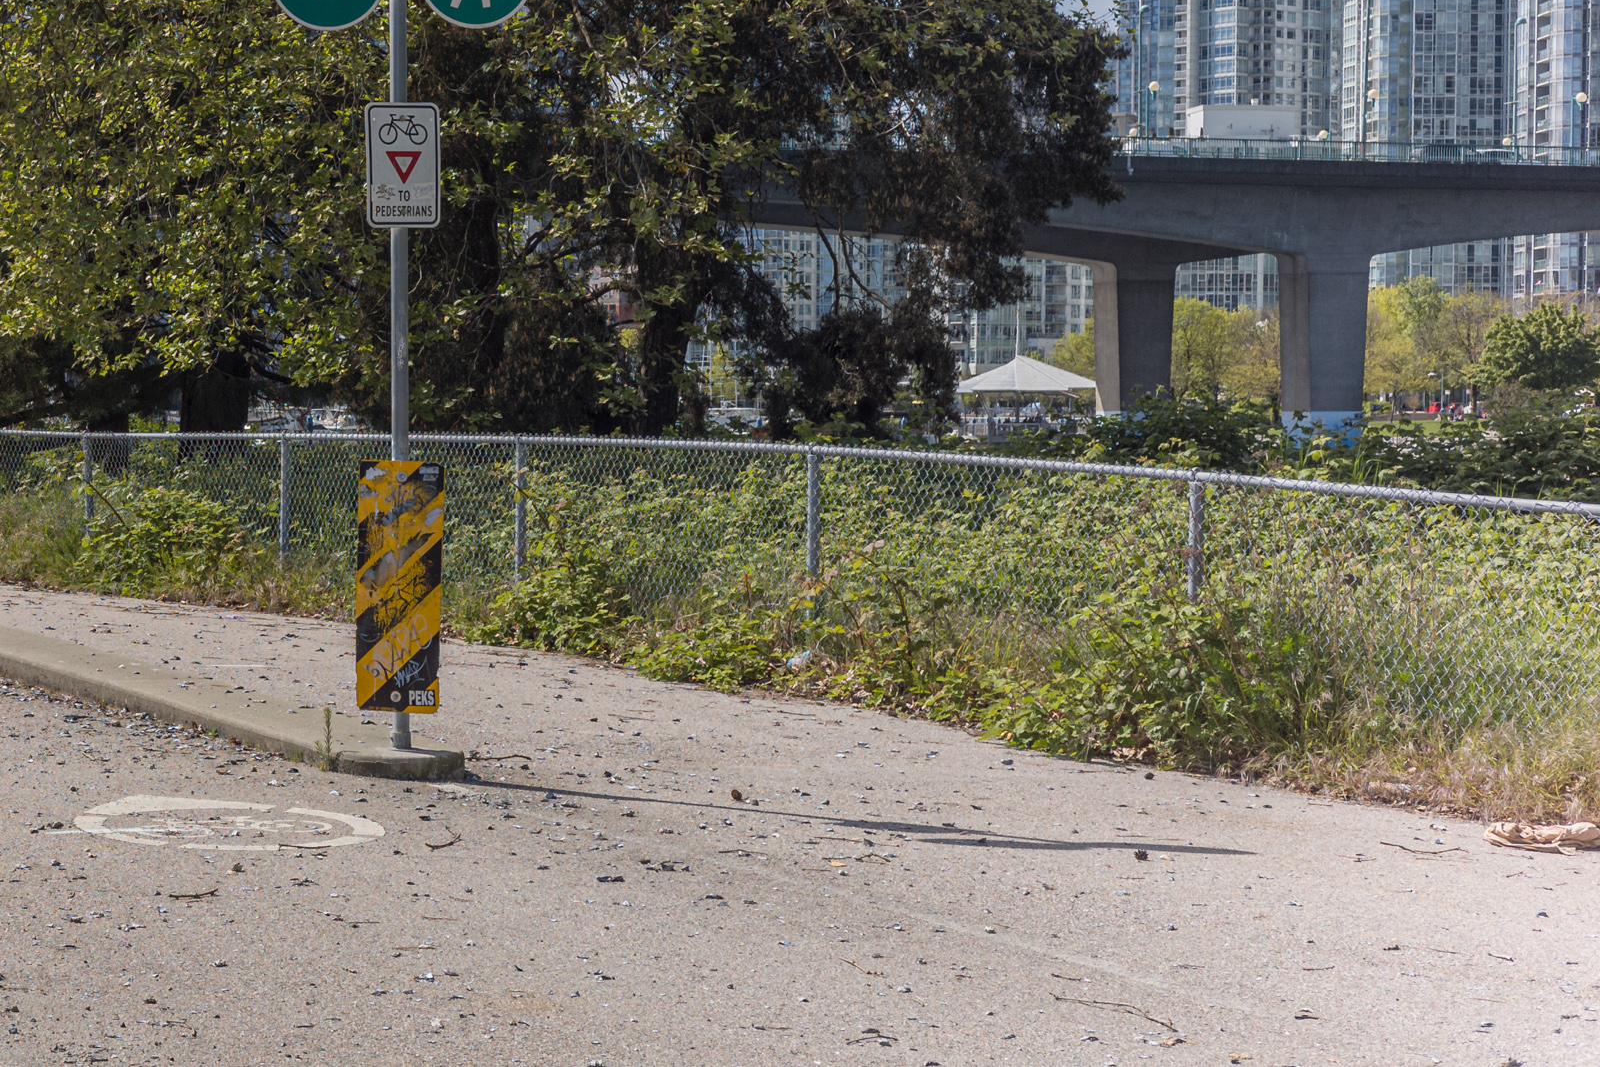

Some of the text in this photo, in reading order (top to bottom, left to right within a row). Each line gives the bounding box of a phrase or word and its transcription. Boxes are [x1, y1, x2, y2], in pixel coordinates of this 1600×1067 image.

[398, 190, 411, 202] TO
[375, 205, 433, 217] PEDESTRIANS
[408, 690, 435, 706] PEKS
